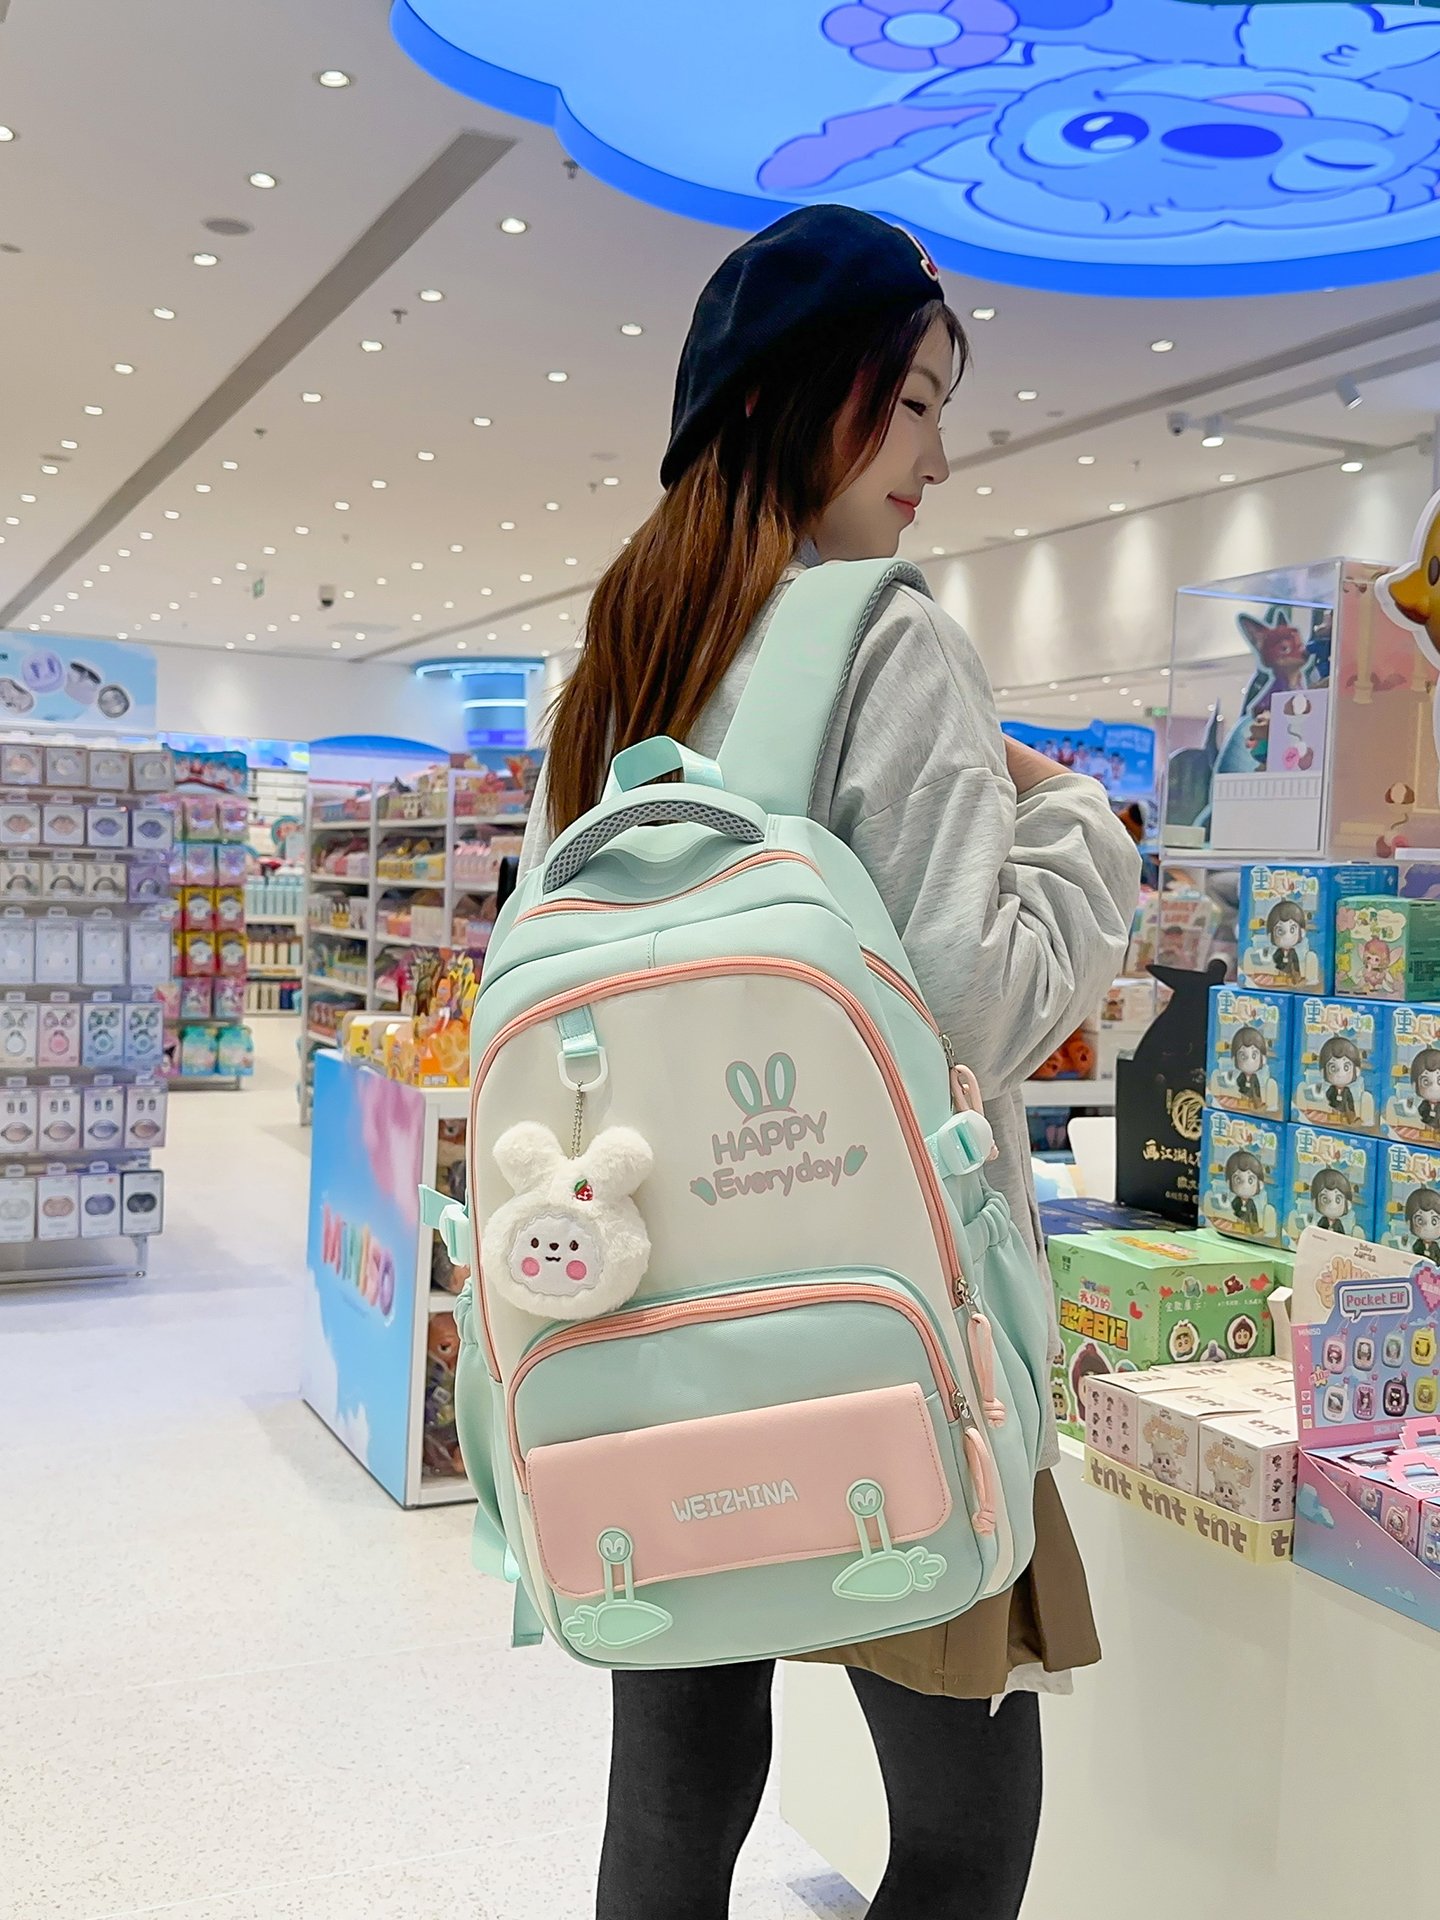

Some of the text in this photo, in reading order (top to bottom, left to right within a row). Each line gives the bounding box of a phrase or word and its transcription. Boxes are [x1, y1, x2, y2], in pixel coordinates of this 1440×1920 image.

[711, 1110, 828, 1166] HAPPY
[1079, 1290, 1111, 1312] 我们的
[1346, 1290, 1406, 1308] Pocket Elf
[1060, 1297, 1129, 1351] 恐龙日记
[671, 1479, 800, 1523] WEIZHINA
[1091, 1457, 1248, 1554] tnt tnt tnt
